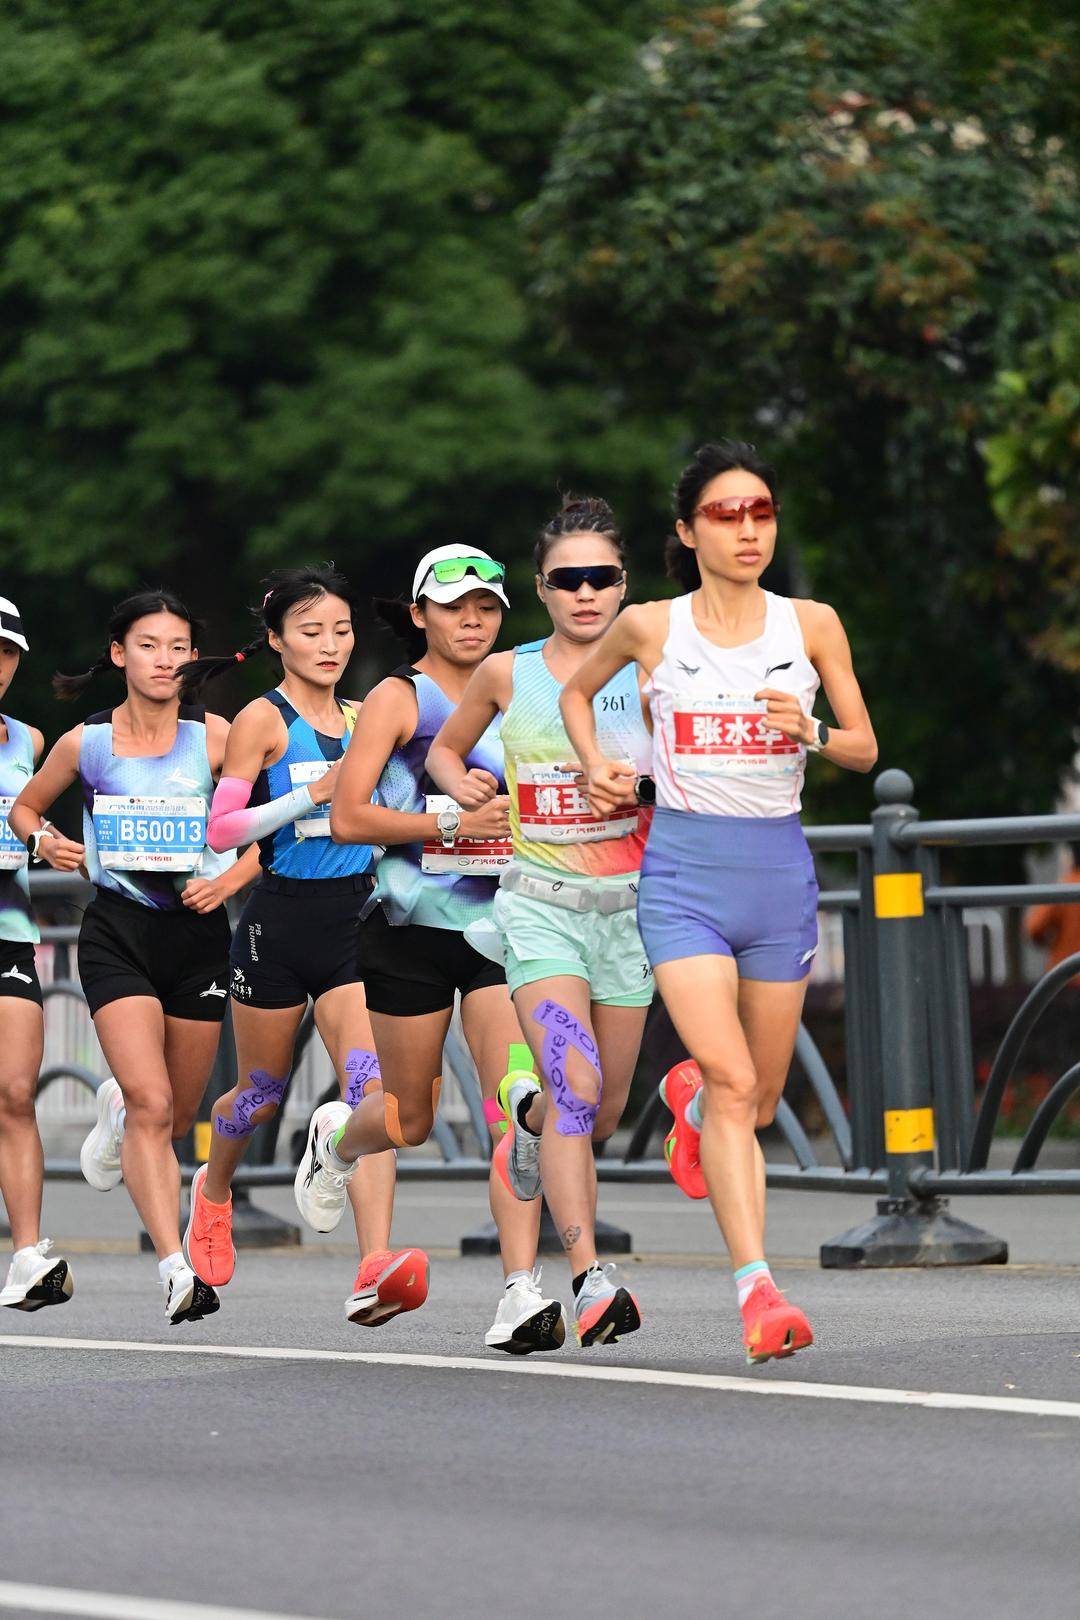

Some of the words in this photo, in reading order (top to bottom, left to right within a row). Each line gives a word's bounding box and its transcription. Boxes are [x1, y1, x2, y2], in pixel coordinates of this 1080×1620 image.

[692, 715, 783, 746] 张水华
[121, 819, 202, 842] B50013
[249, 925, 259, 962] RUNNER
